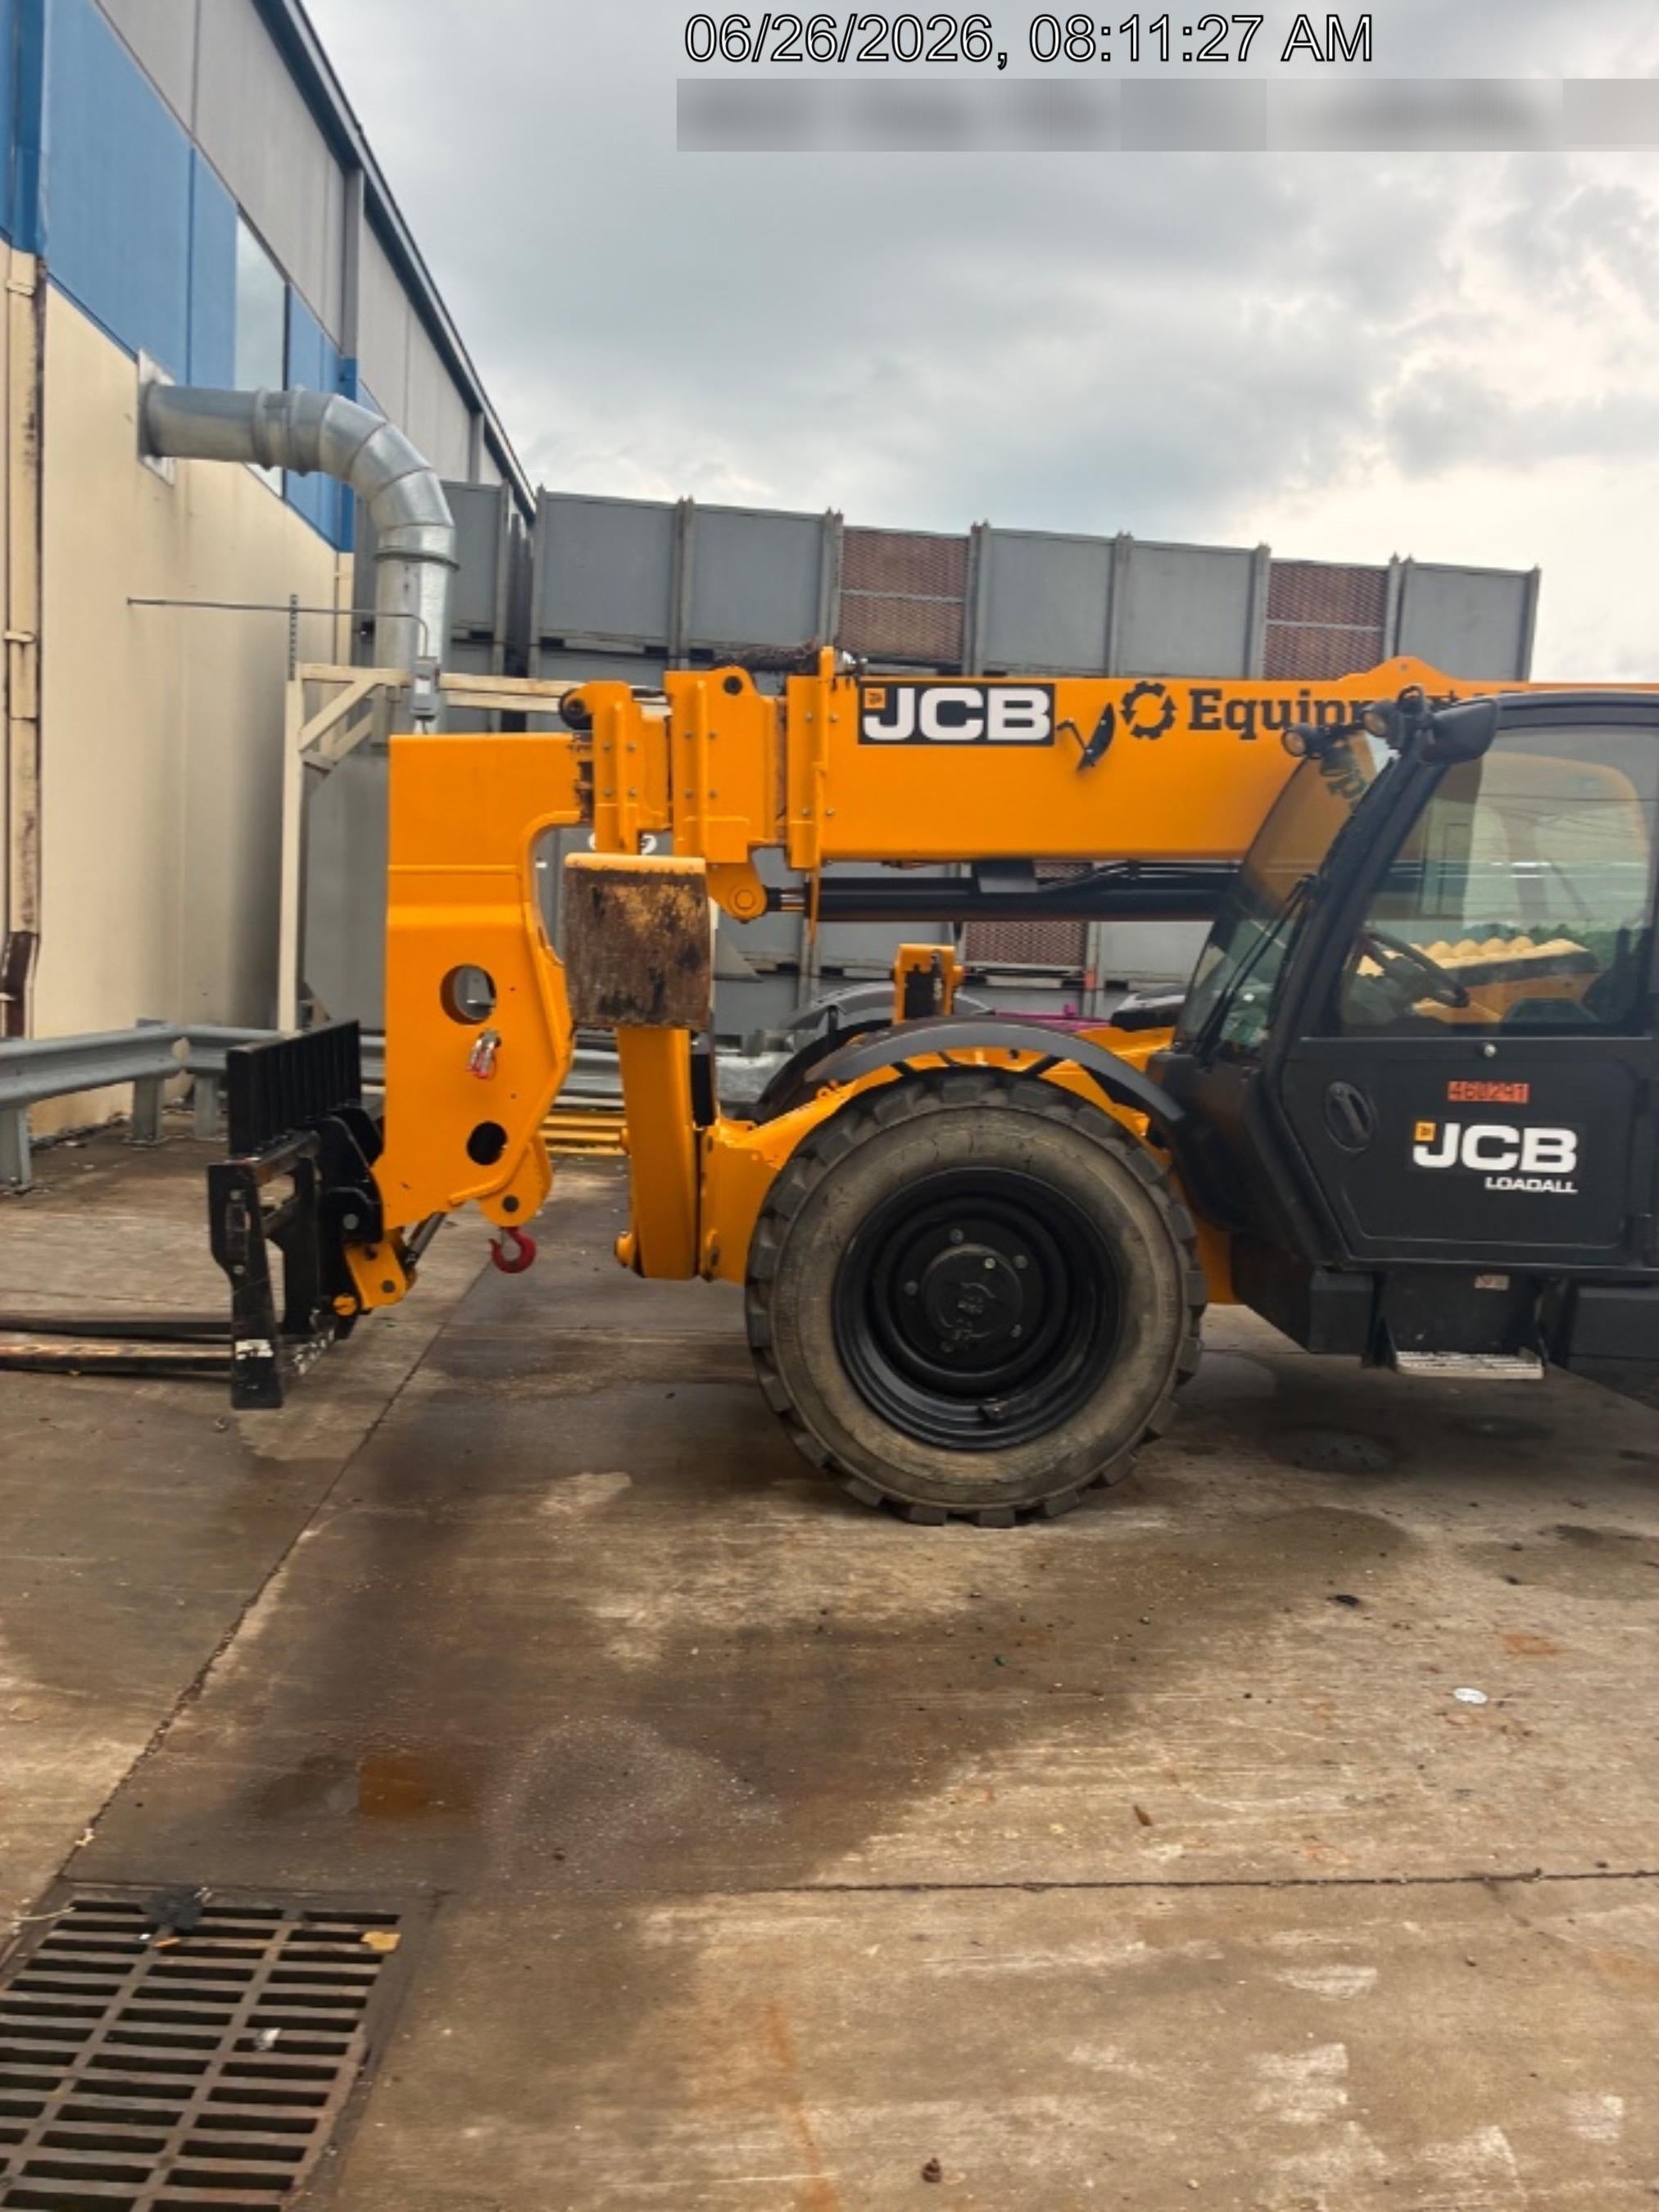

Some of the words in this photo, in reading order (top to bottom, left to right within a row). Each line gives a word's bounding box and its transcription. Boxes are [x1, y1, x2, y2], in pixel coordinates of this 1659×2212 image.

[863, 687, 1051, 741] JCB
[1413, 1122, 1577, 1173] JCB
[1484, 1177, 1578, 1194] LOADALL
